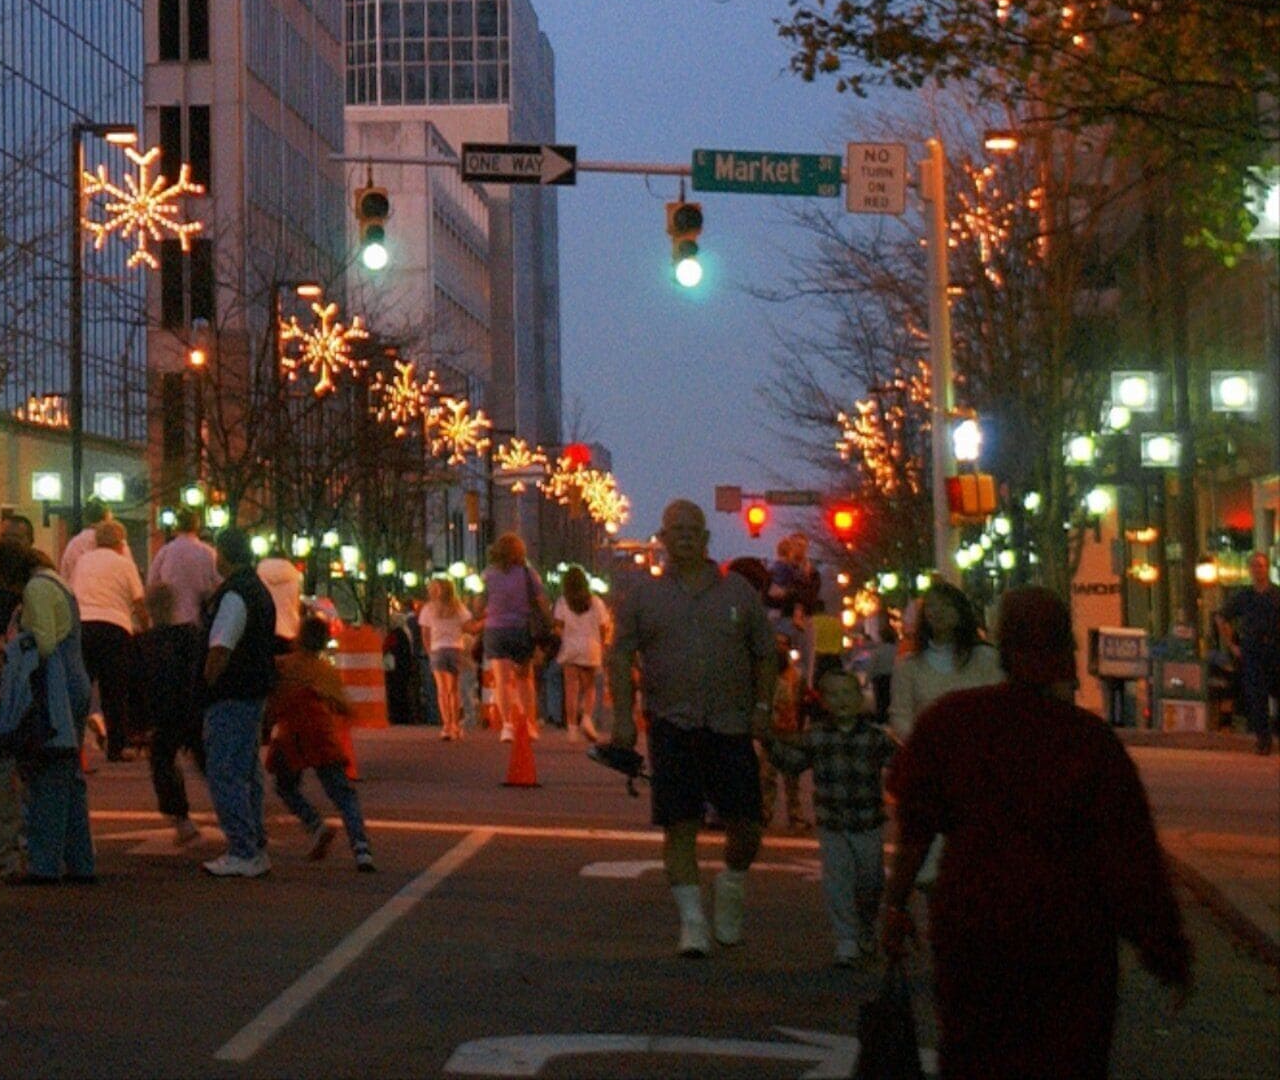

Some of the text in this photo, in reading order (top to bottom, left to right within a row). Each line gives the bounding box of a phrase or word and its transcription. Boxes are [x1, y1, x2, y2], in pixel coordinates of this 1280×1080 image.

[865, 148, 889, 163] NO
[469, 155, 544, 173] ONE WAY
[714, 152, 801, 184] Market
[861, 166, 893, 178] TURN
[868, 181, 886, 193] ON
[865, 196, 889, 208] RED
